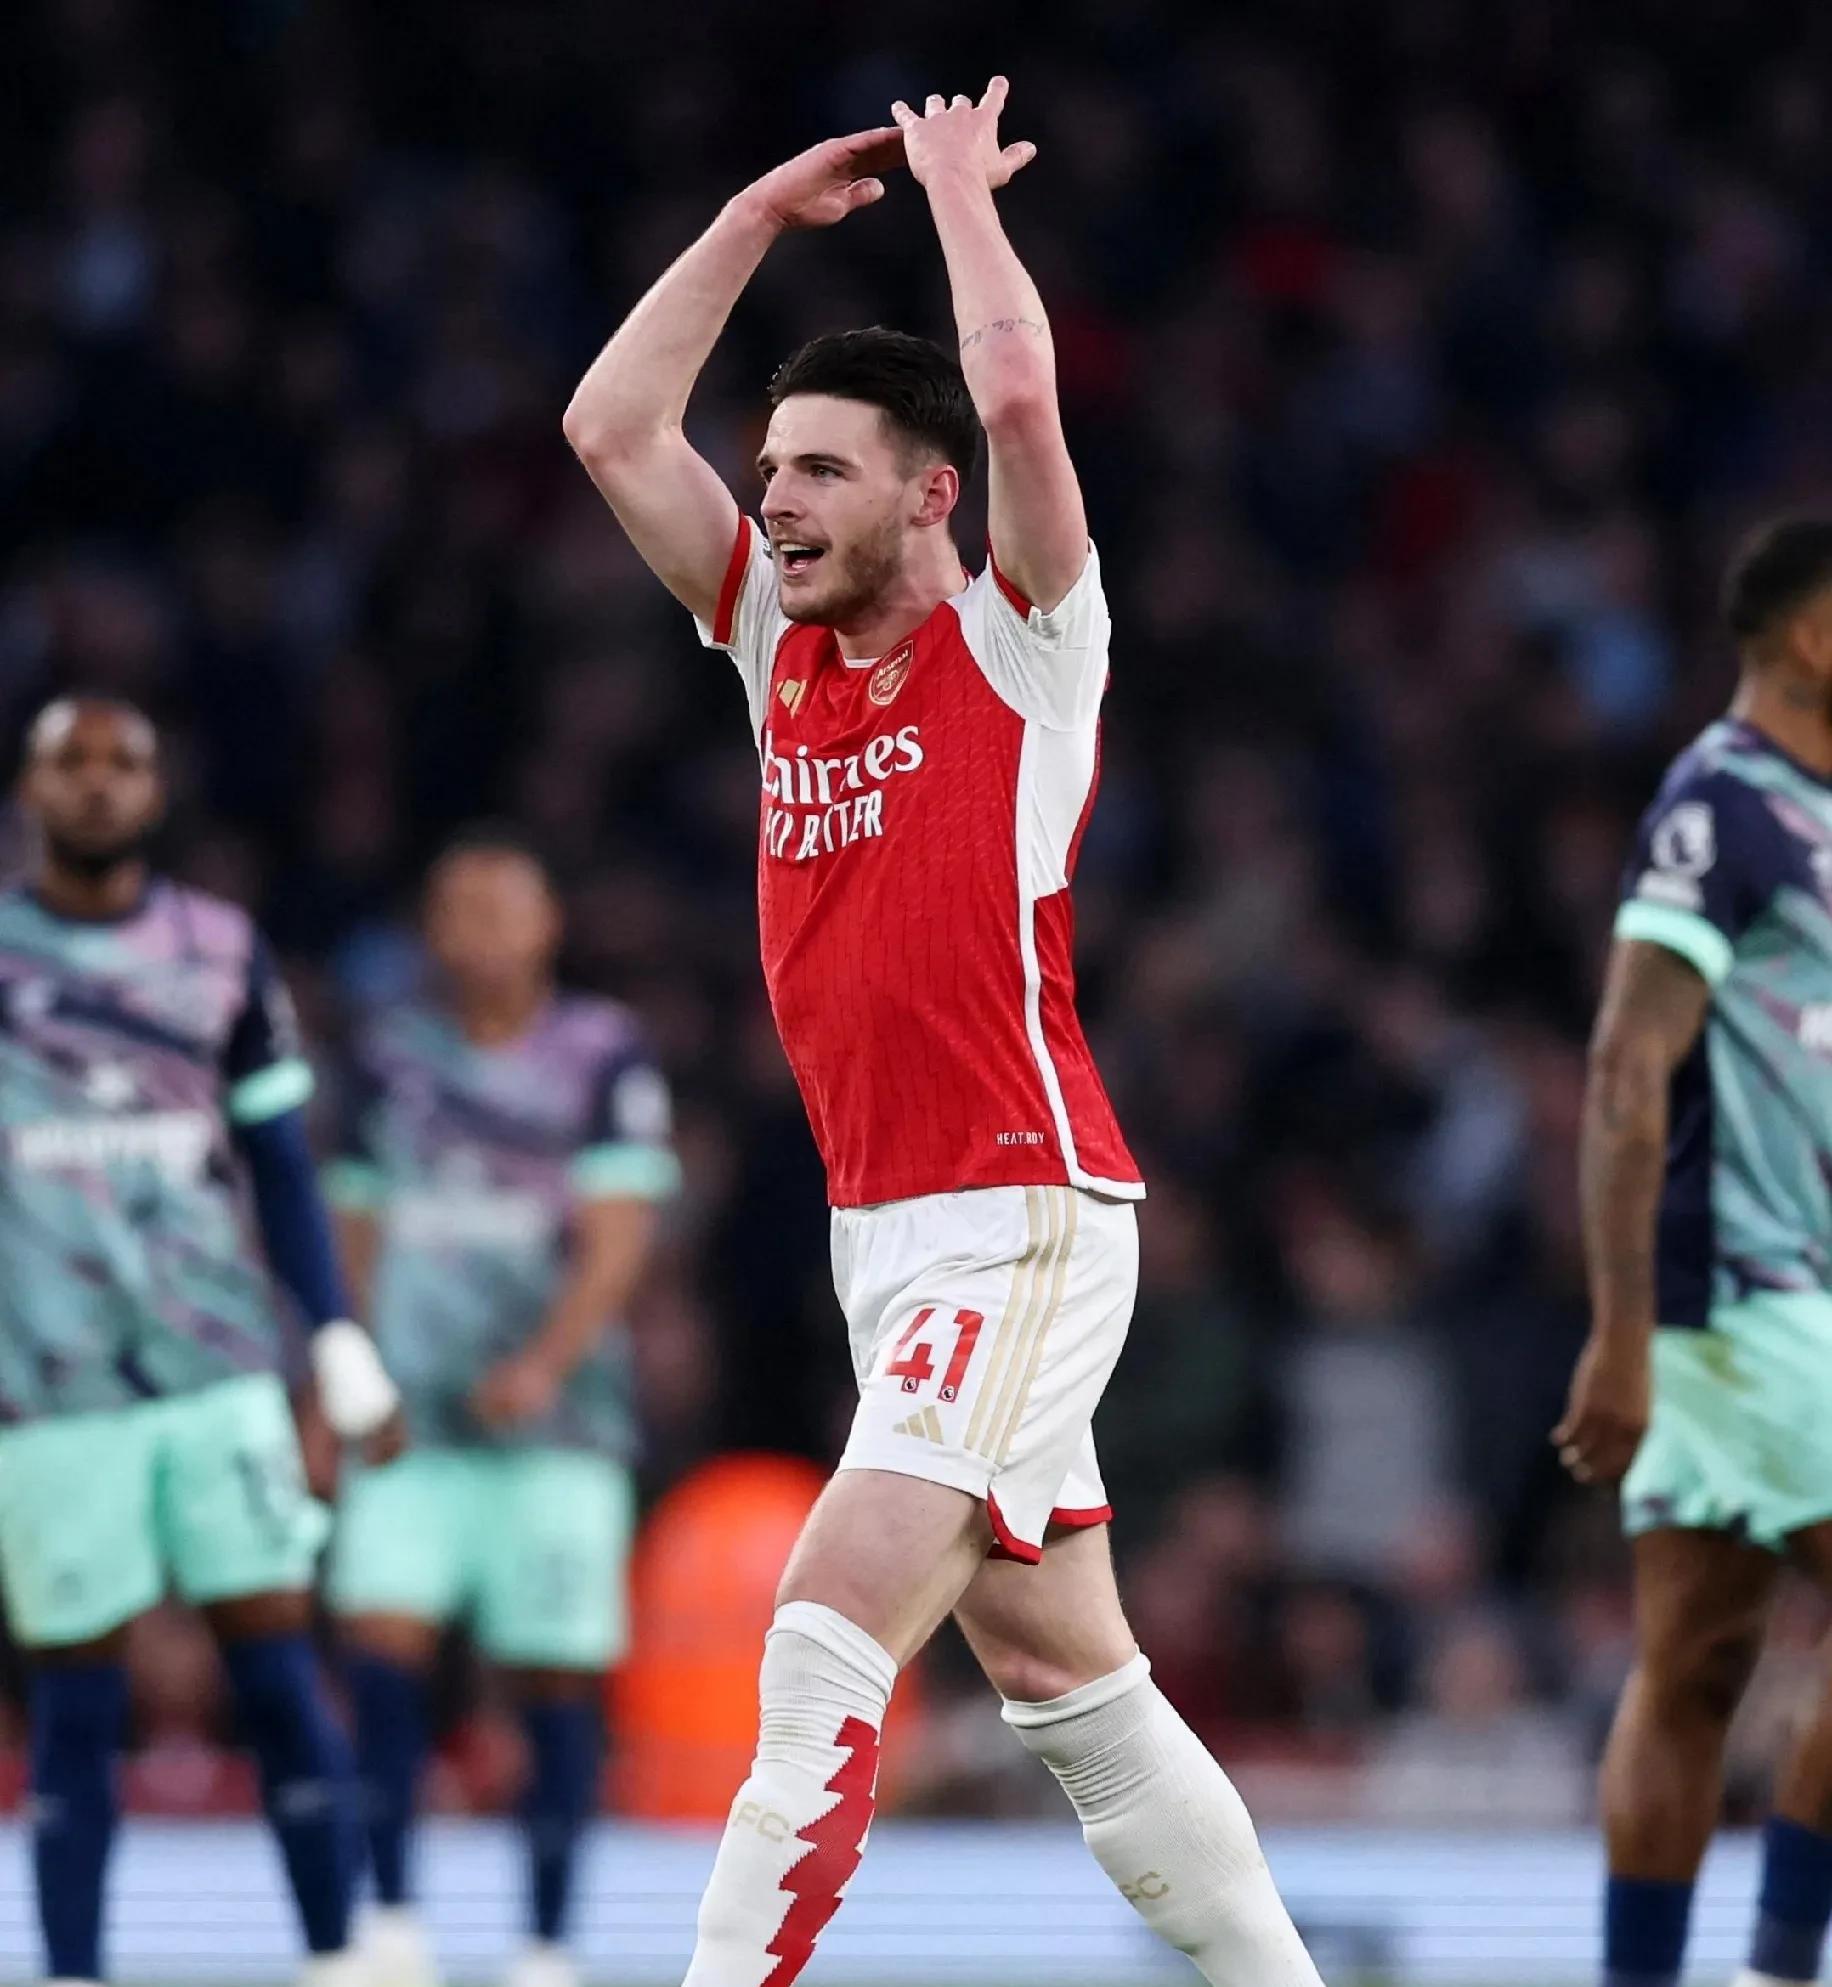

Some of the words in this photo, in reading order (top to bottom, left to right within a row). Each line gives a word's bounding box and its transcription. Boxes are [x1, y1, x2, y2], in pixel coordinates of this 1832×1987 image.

[876, 649, 909, 681] Arsenal
[762, 725, 923, 804] miraes
[996, 1131, 1045, 1145] HEAT.RDY
[884, 1308, 984, 1403] 41
[732, 1800, 790, 1843] FC
